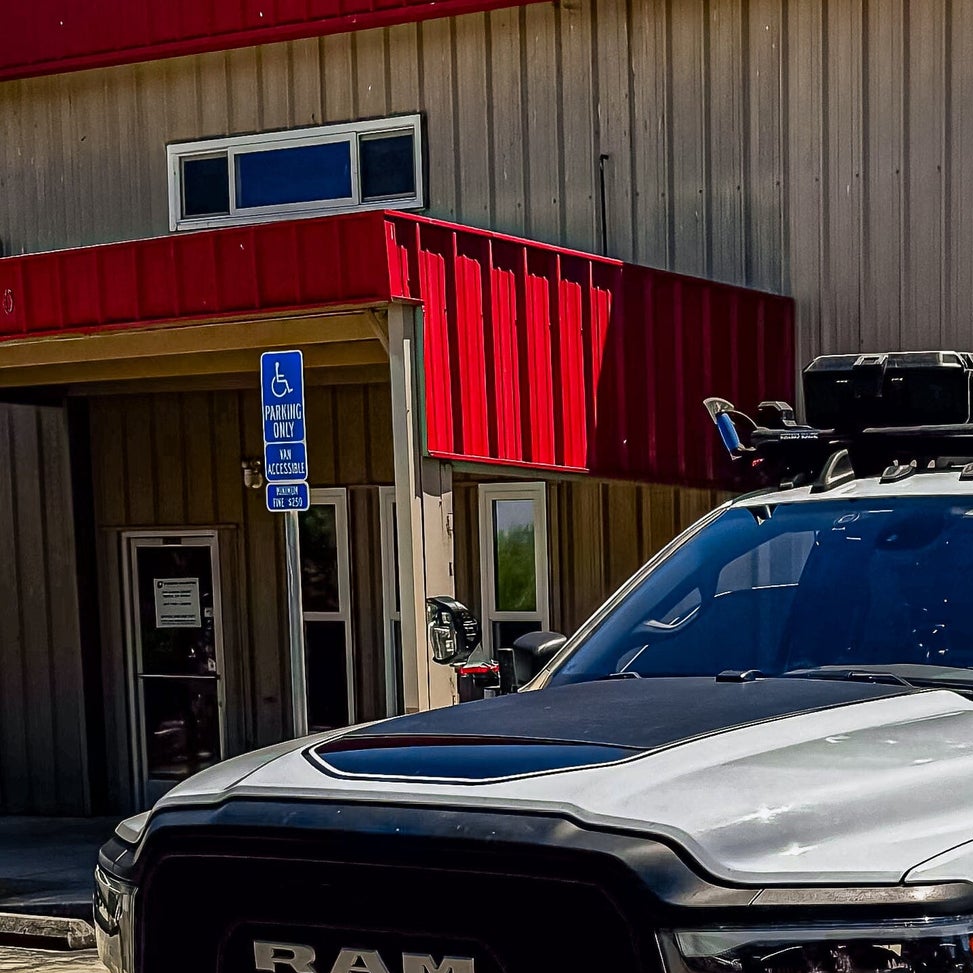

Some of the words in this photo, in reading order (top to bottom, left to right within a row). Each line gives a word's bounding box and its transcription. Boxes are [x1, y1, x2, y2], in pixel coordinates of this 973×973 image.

[265, 403, 302, 420] PARKING
[273, 422, 295, 438] ONLY
[268, 462, 305, 475] ACCESSIBLE
